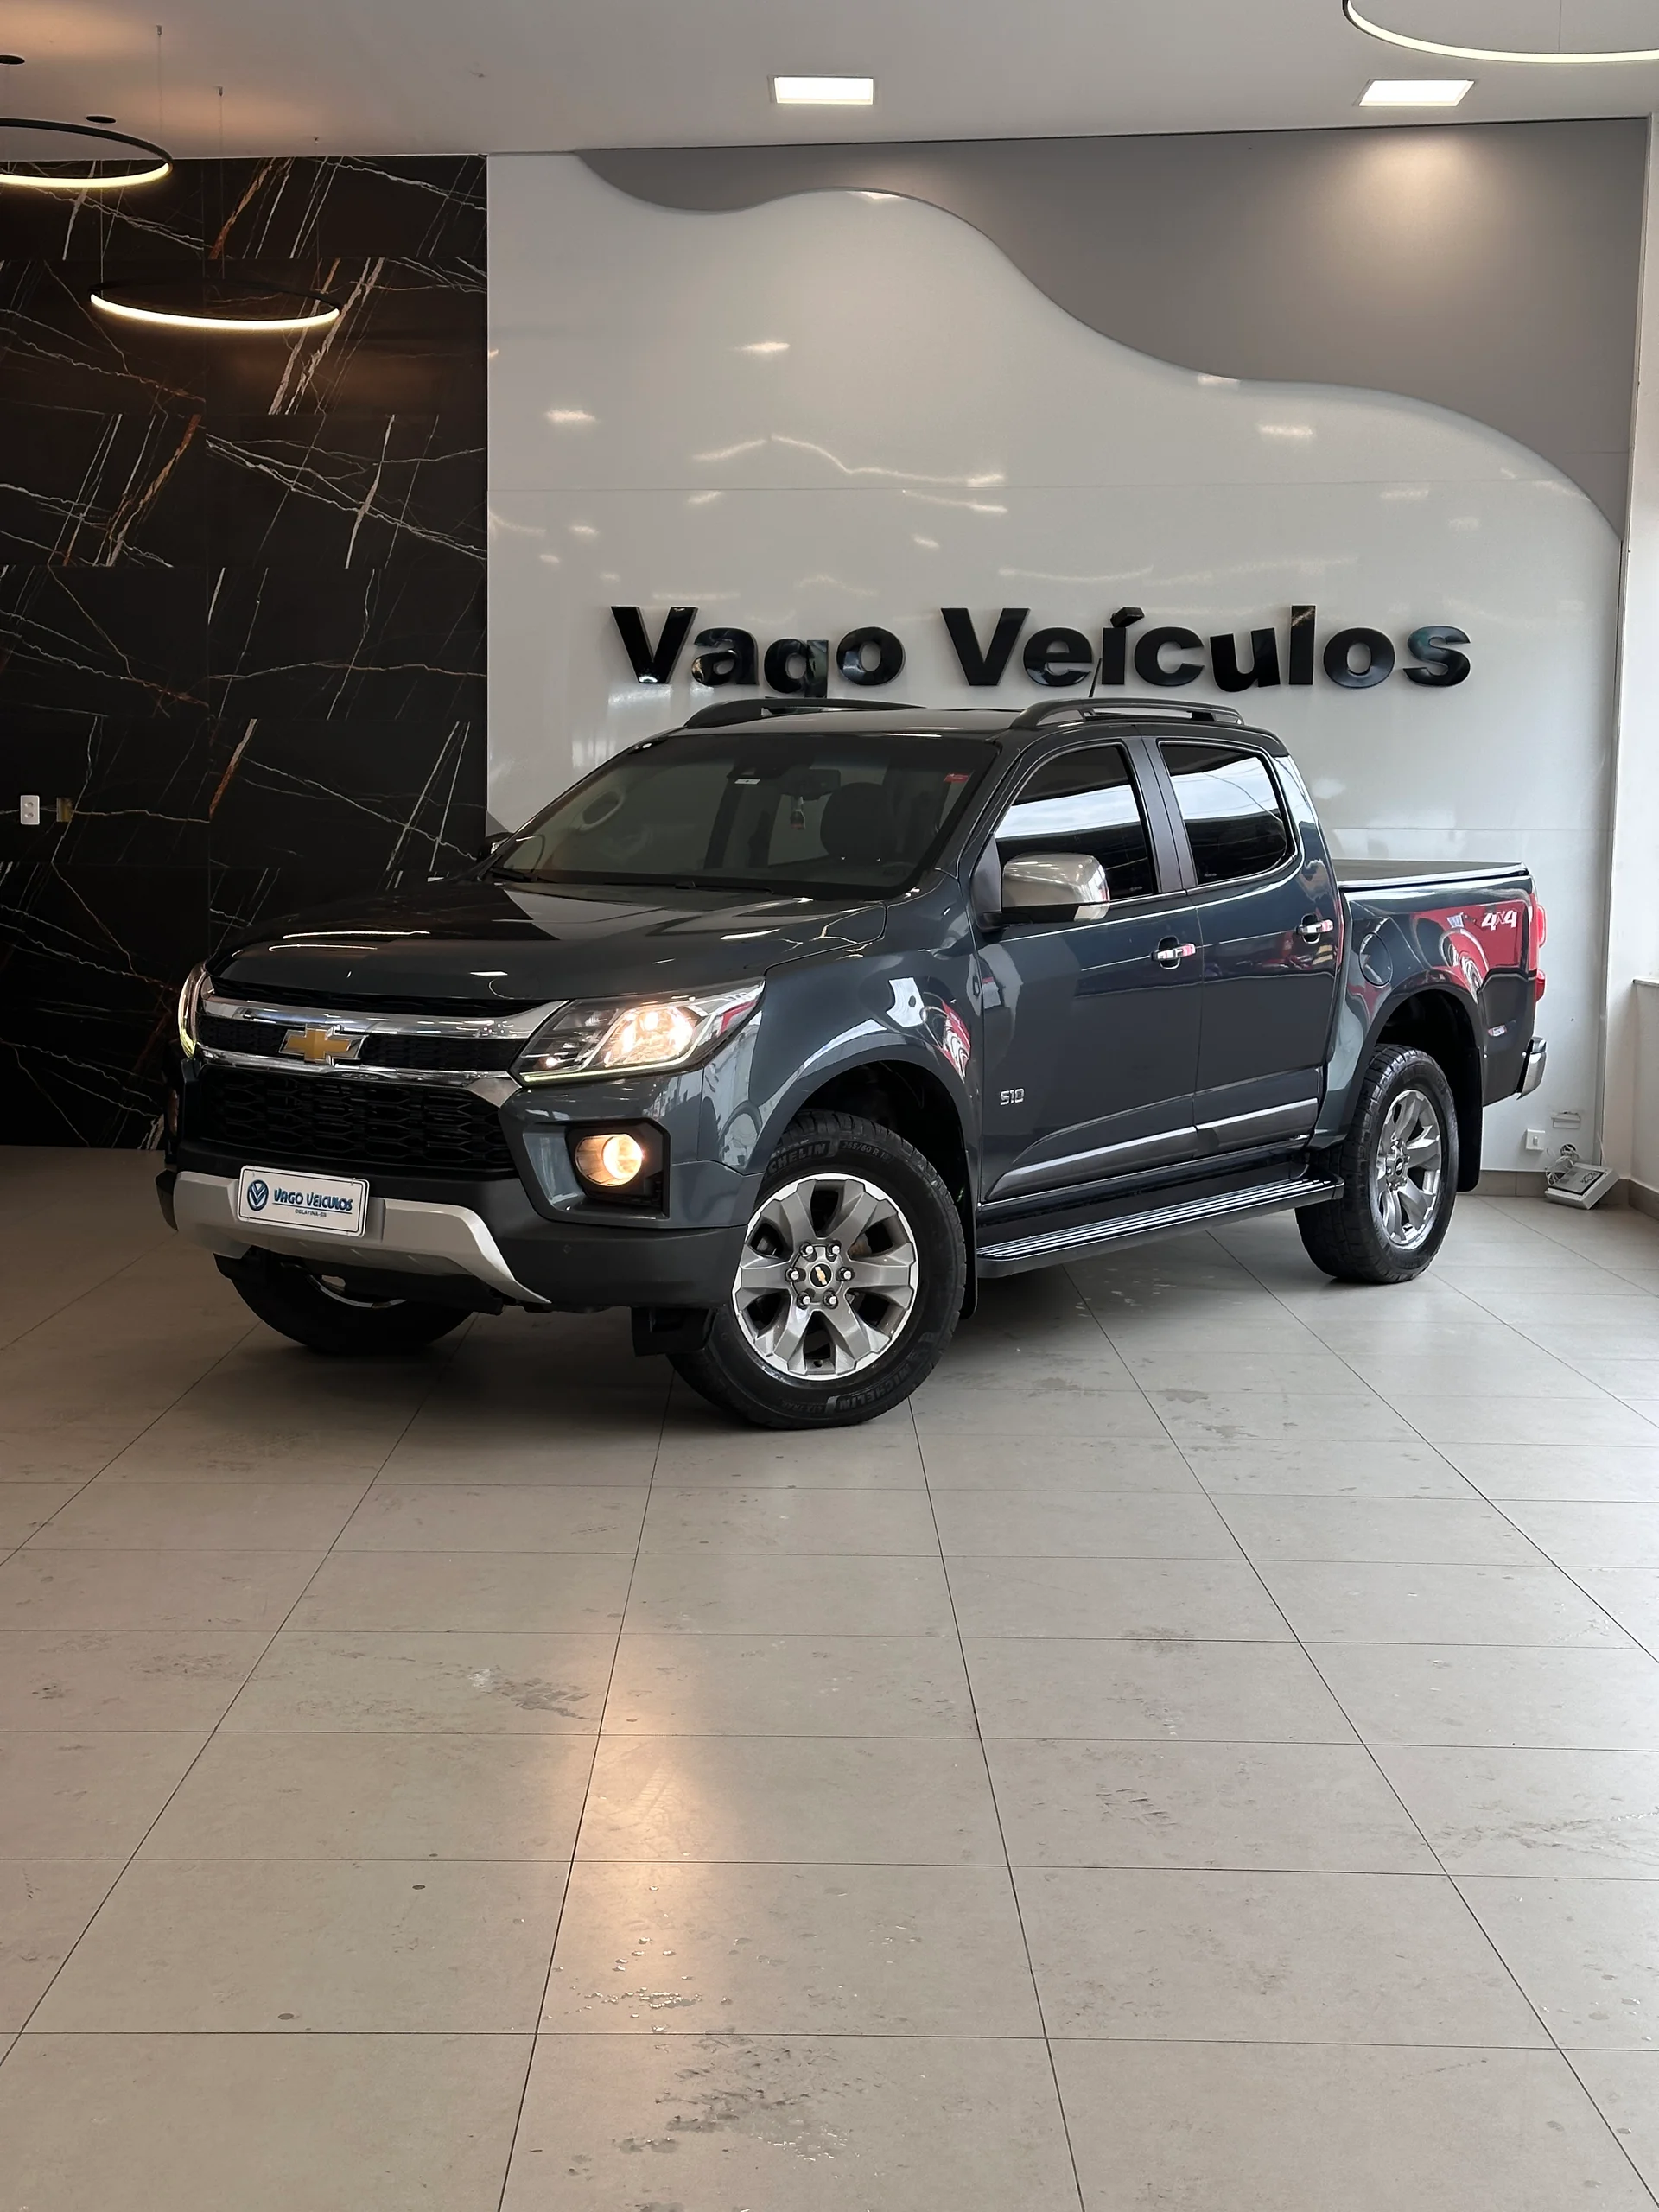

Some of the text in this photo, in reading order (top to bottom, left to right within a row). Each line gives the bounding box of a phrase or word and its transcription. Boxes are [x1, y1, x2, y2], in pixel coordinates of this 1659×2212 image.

[611, 604, 1471, 698] Vago Veículos
[1000, 1088, 1025, 1106] S10
[767, 1142, 827, 1173] CHELIN
[274, 1187, 303, 1204] VAGO
